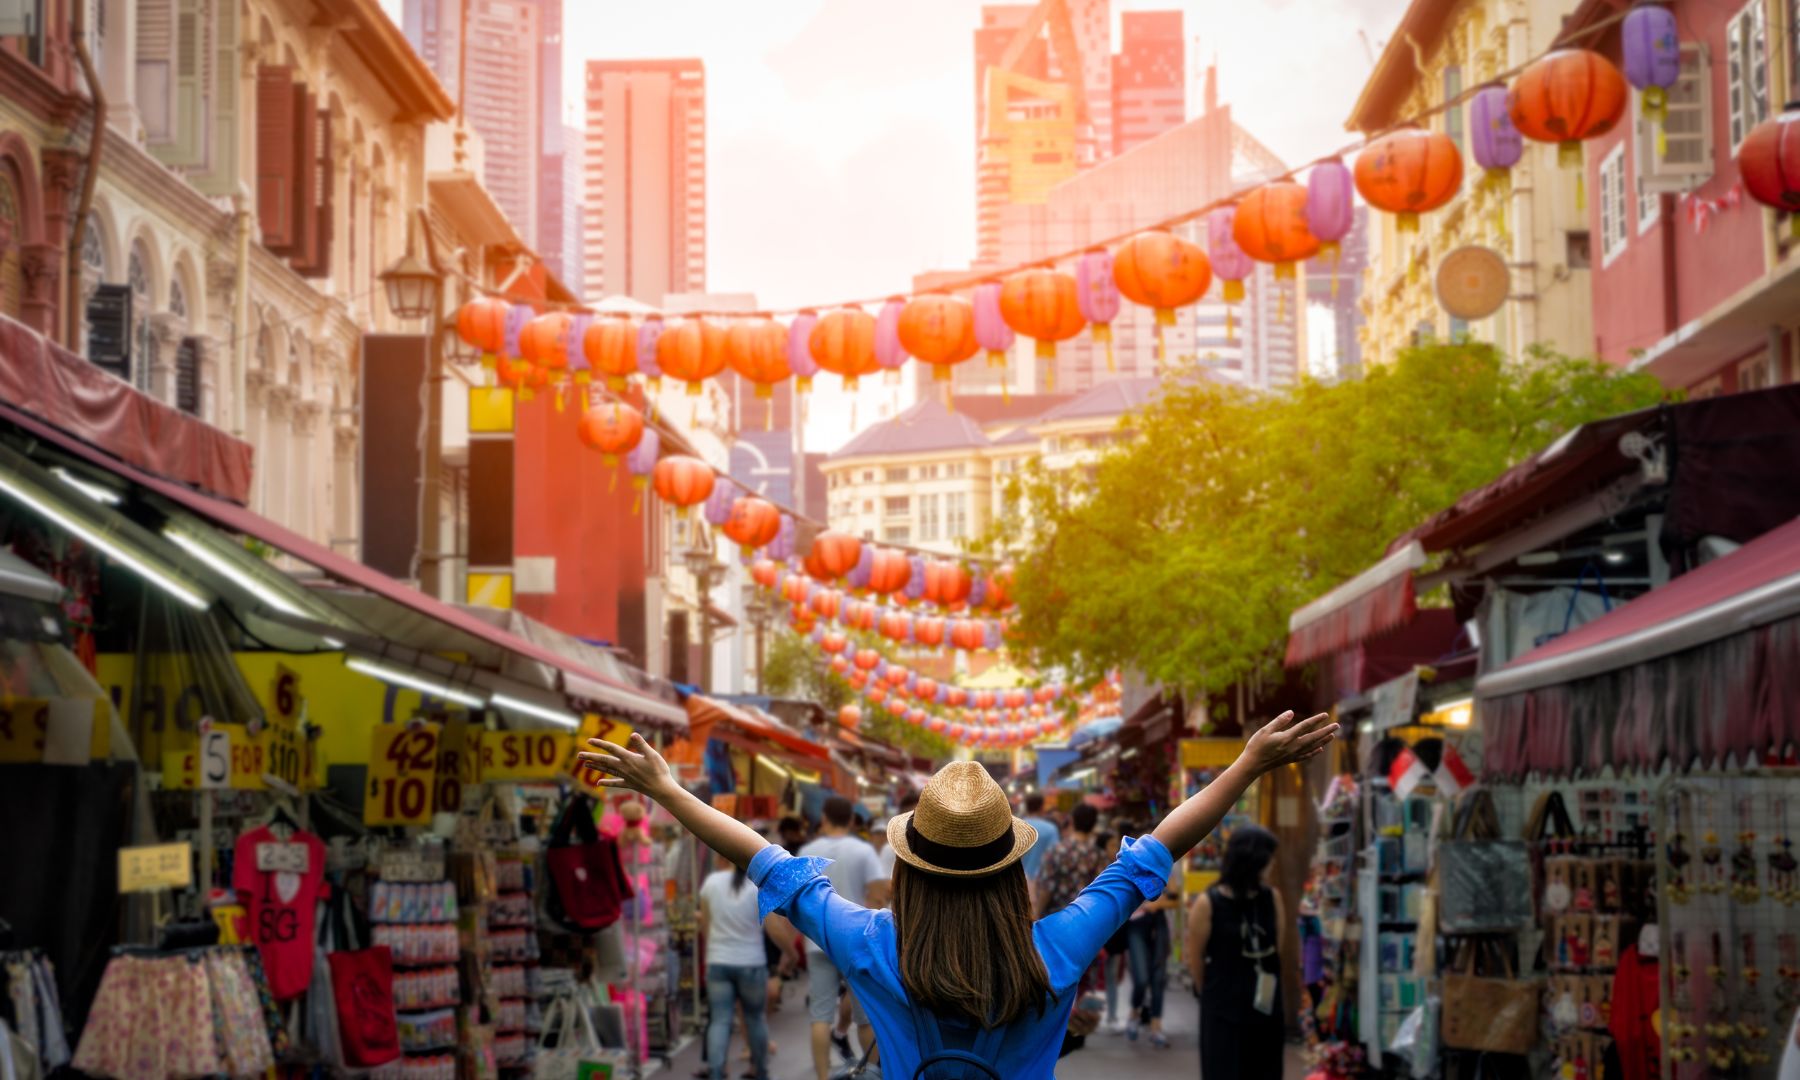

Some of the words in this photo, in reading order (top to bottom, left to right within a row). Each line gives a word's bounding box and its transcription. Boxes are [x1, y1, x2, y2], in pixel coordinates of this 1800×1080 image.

[276, 675, 295, 717] 6
[205, 734, 227, 783] 5
[232, 746, 263, 775] FOR
[387, 731, 436, 771] 42
[502, 737, 555, 767] $10
